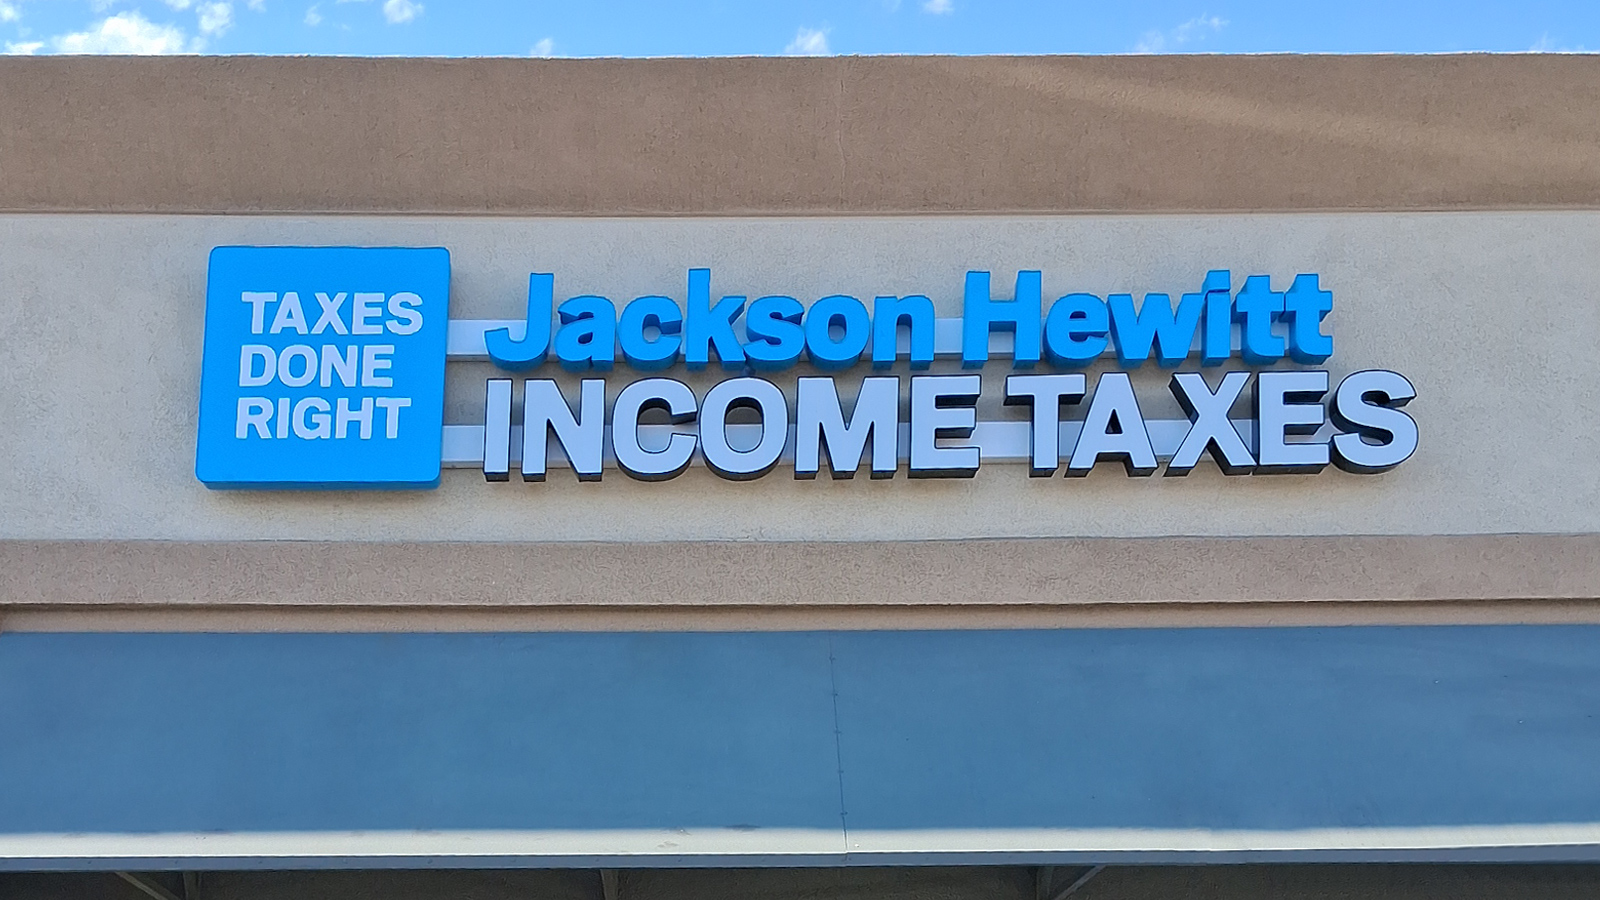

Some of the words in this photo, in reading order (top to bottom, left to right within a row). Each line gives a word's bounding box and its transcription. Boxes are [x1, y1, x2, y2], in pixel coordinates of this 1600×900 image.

[241, 291, 424, 335] TAXES
[484, 268, 936, 367] Jackson
[962, 269, 1333, 364] Hewitt
[238, 344, 395, 388] DONE
[235, 396, 412, 439] RIGHT
[483, 375, 982, 477] INCOME
[1004, 369, 1419, 474] TAXES
